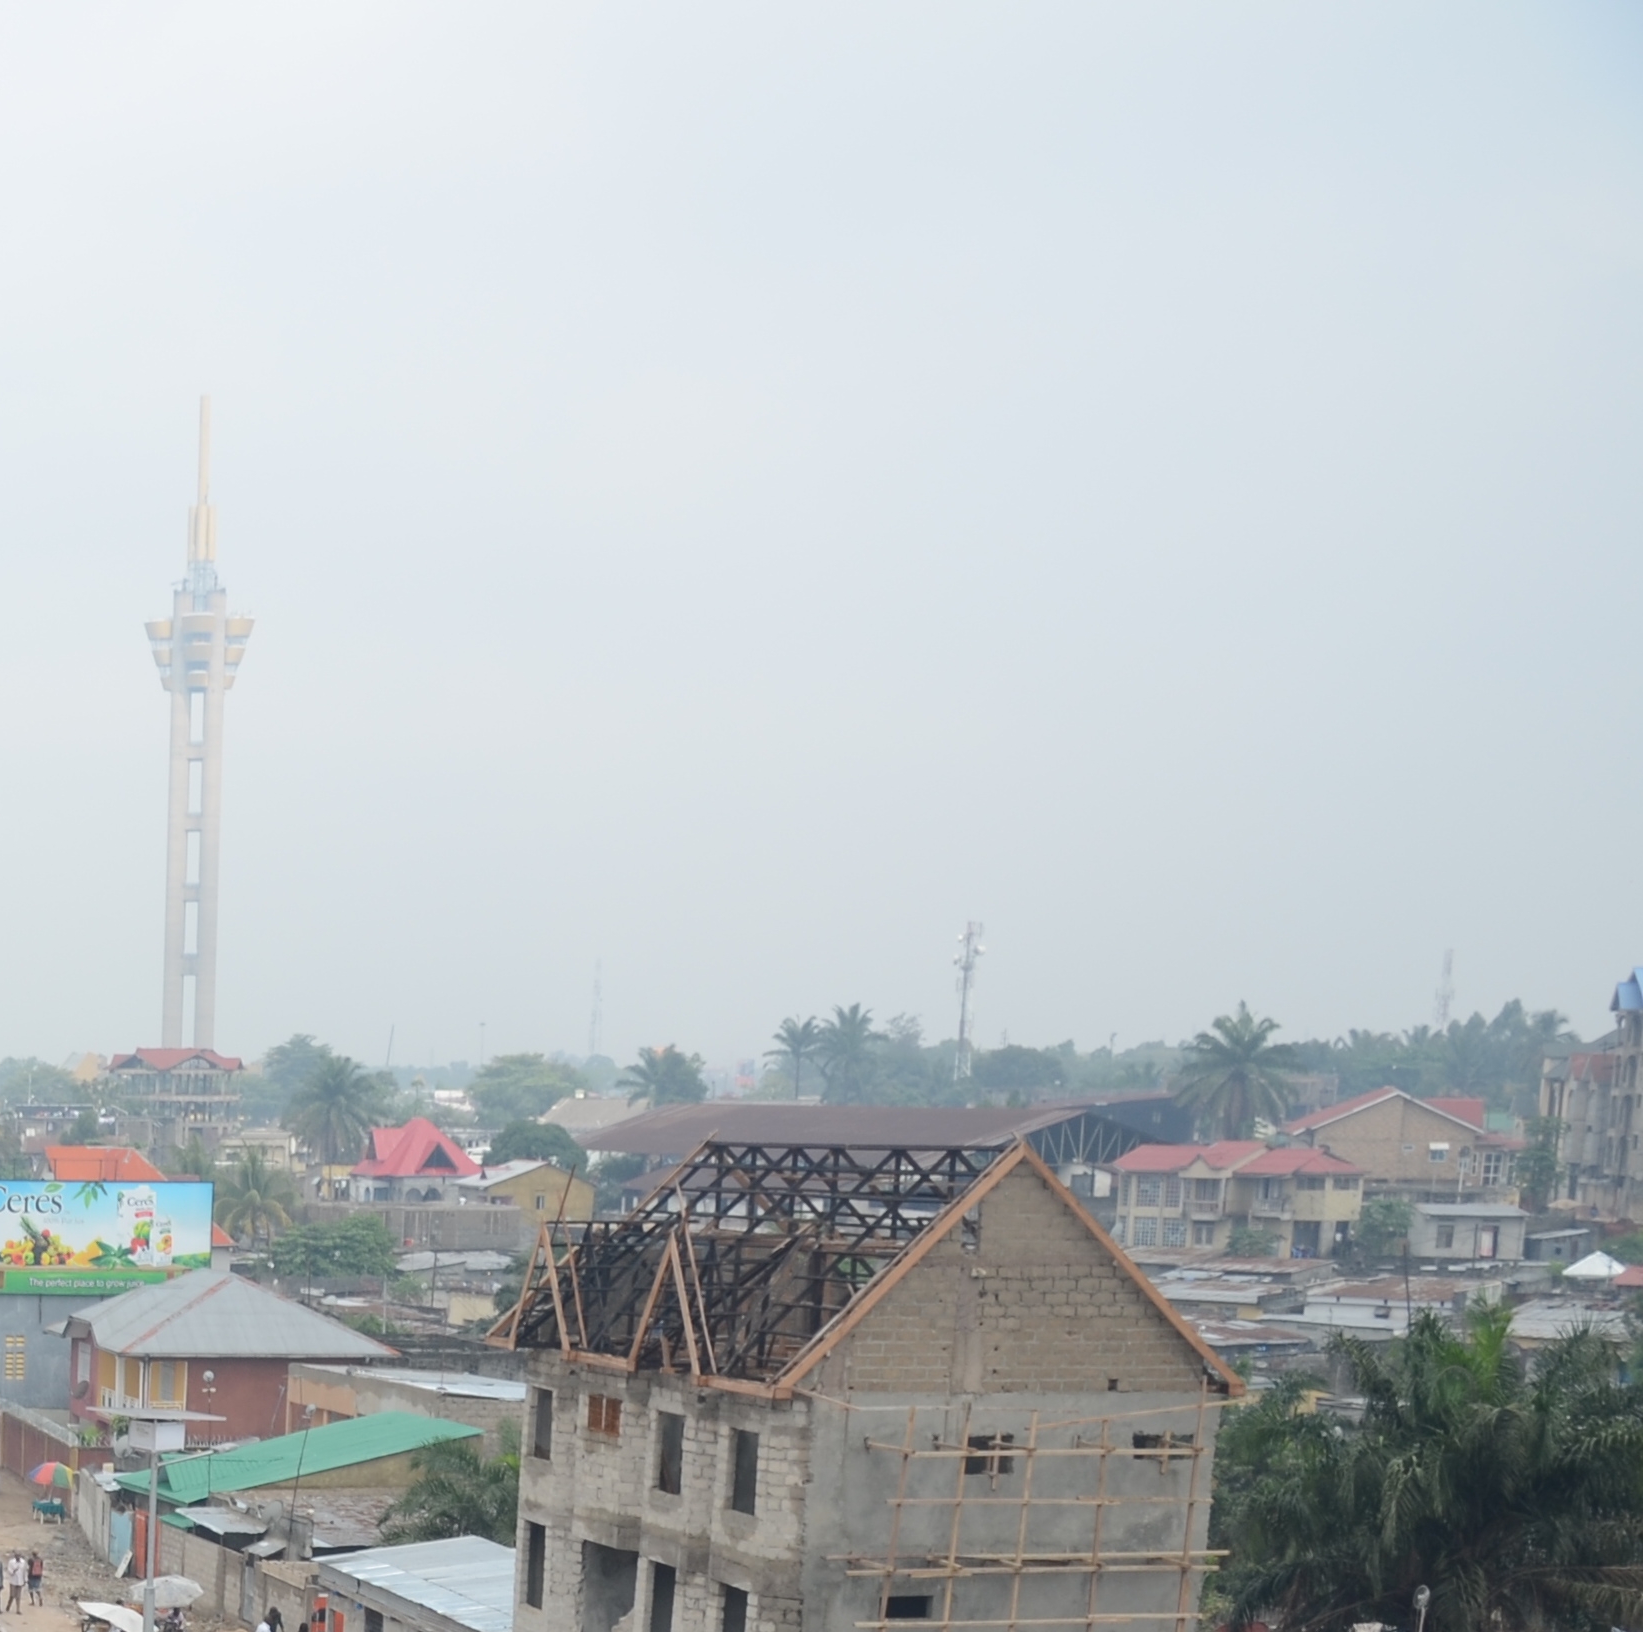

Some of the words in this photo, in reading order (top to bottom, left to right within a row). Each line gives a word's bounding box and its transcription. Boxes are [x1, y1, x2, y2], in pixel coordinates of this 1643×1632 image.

[127, 1197, 154, 1207] Ceres
[29, 1277, 43, 1287] The
[45, 1278, 72, 1289] perfect
[73, 1279, 95, 1289] place
[96, 1280, 104, 1288] to
[105, 1281, 125, 1290] grow
